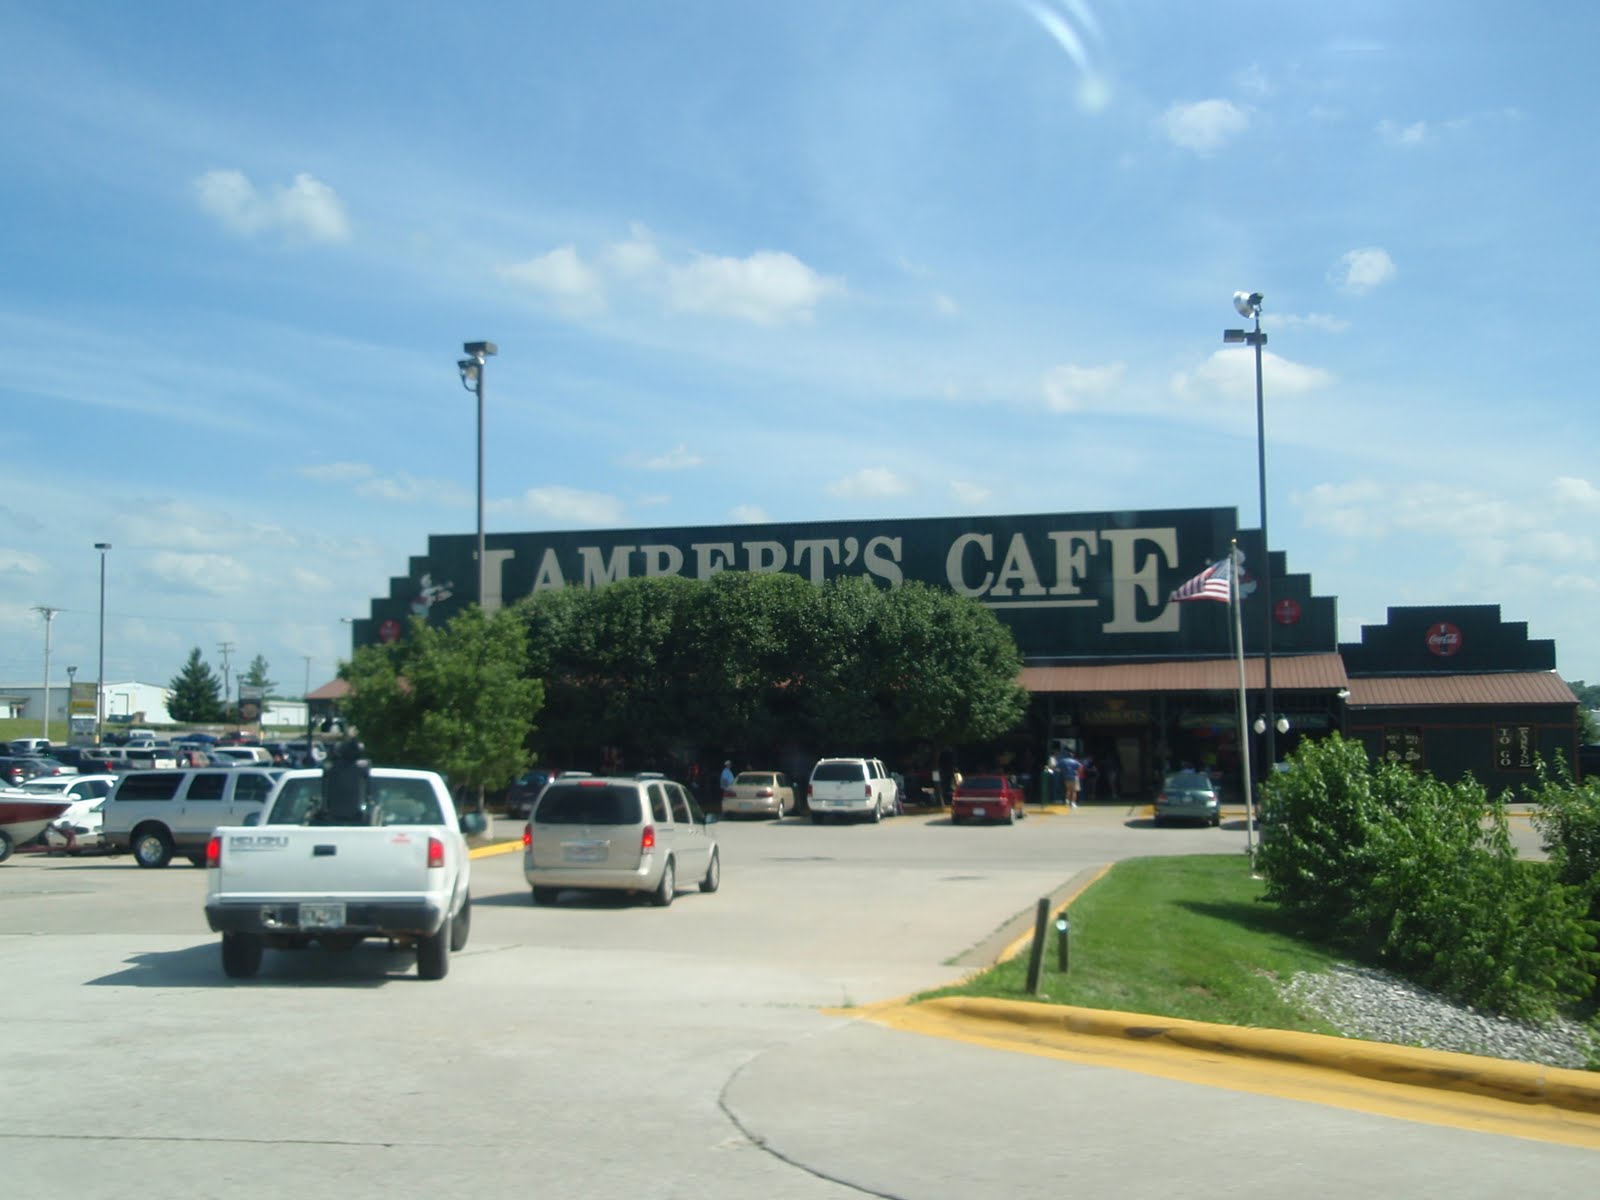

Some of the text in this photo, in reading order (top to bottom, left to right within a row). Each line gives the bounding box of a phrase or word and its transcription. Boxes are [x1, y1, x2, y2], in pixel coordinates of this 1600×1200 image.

[946, 527, 1180, 634] CAFE
[1500, 728, 1510, 744] TO
[1501, 750, 1511, 766] GO
